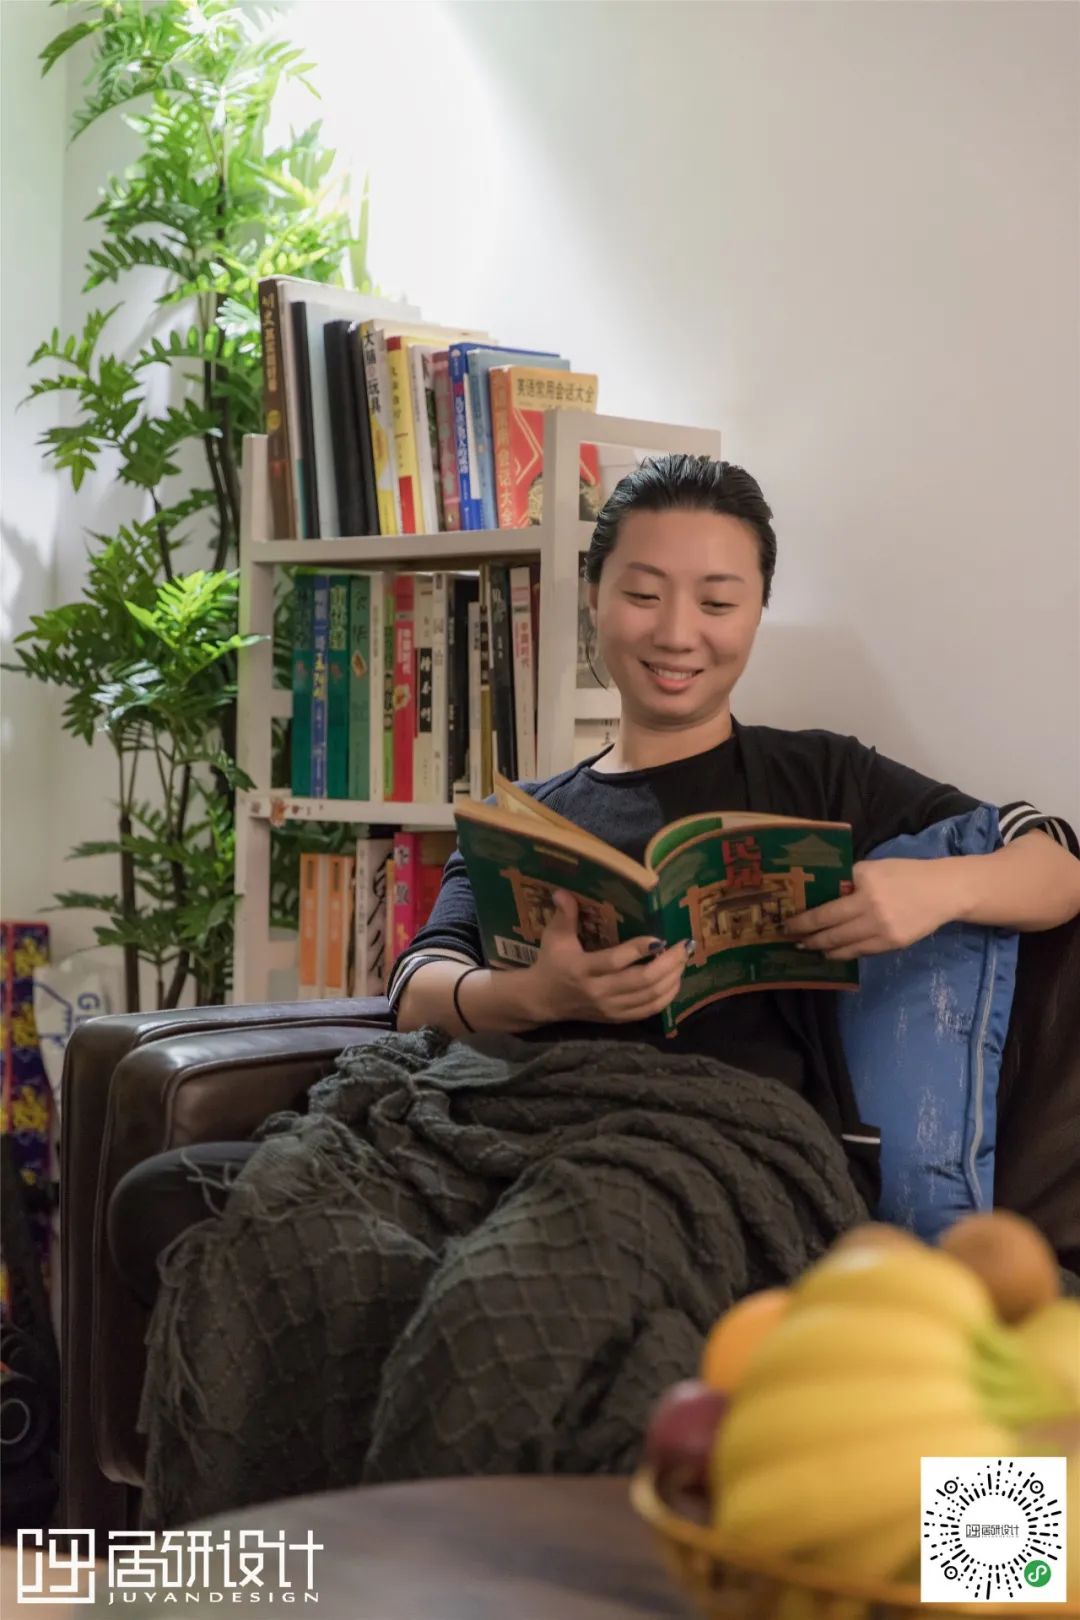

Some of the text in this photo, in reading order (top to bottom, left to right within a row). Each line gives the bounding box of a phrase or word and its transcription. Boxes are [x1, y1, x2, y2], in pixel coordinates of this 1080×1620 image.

[516, 377, 595, 403] 英语常用会话大全
